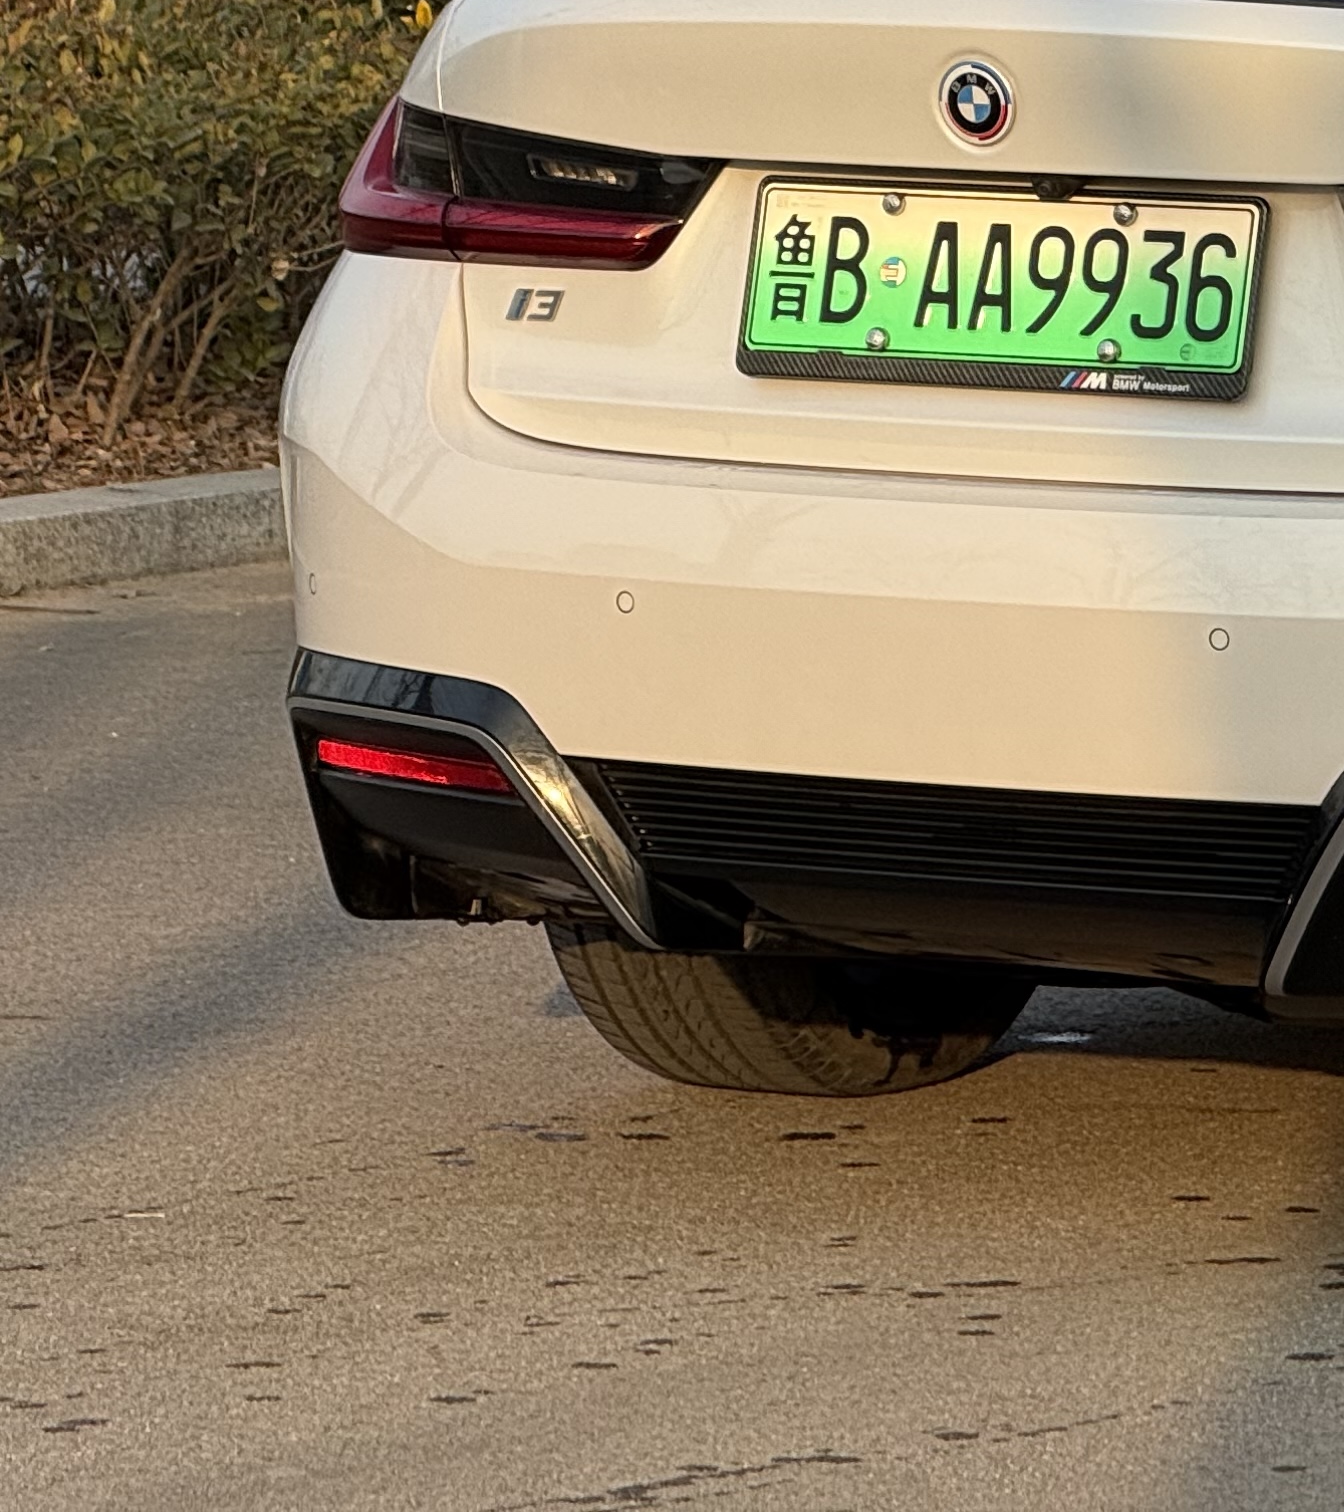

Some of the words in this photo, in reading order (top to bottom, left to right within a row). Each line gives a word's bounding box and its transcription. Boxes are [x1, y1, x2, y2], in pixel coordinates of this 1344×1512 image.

[951, 73, 997, 96] BMW
[913, 221, 1238, 343] AA9936
[1080, 371, 1107, 390] M
[1112, 379, 1141, 391] BMW
[1143, 380, 1190, 393] Motorsport
